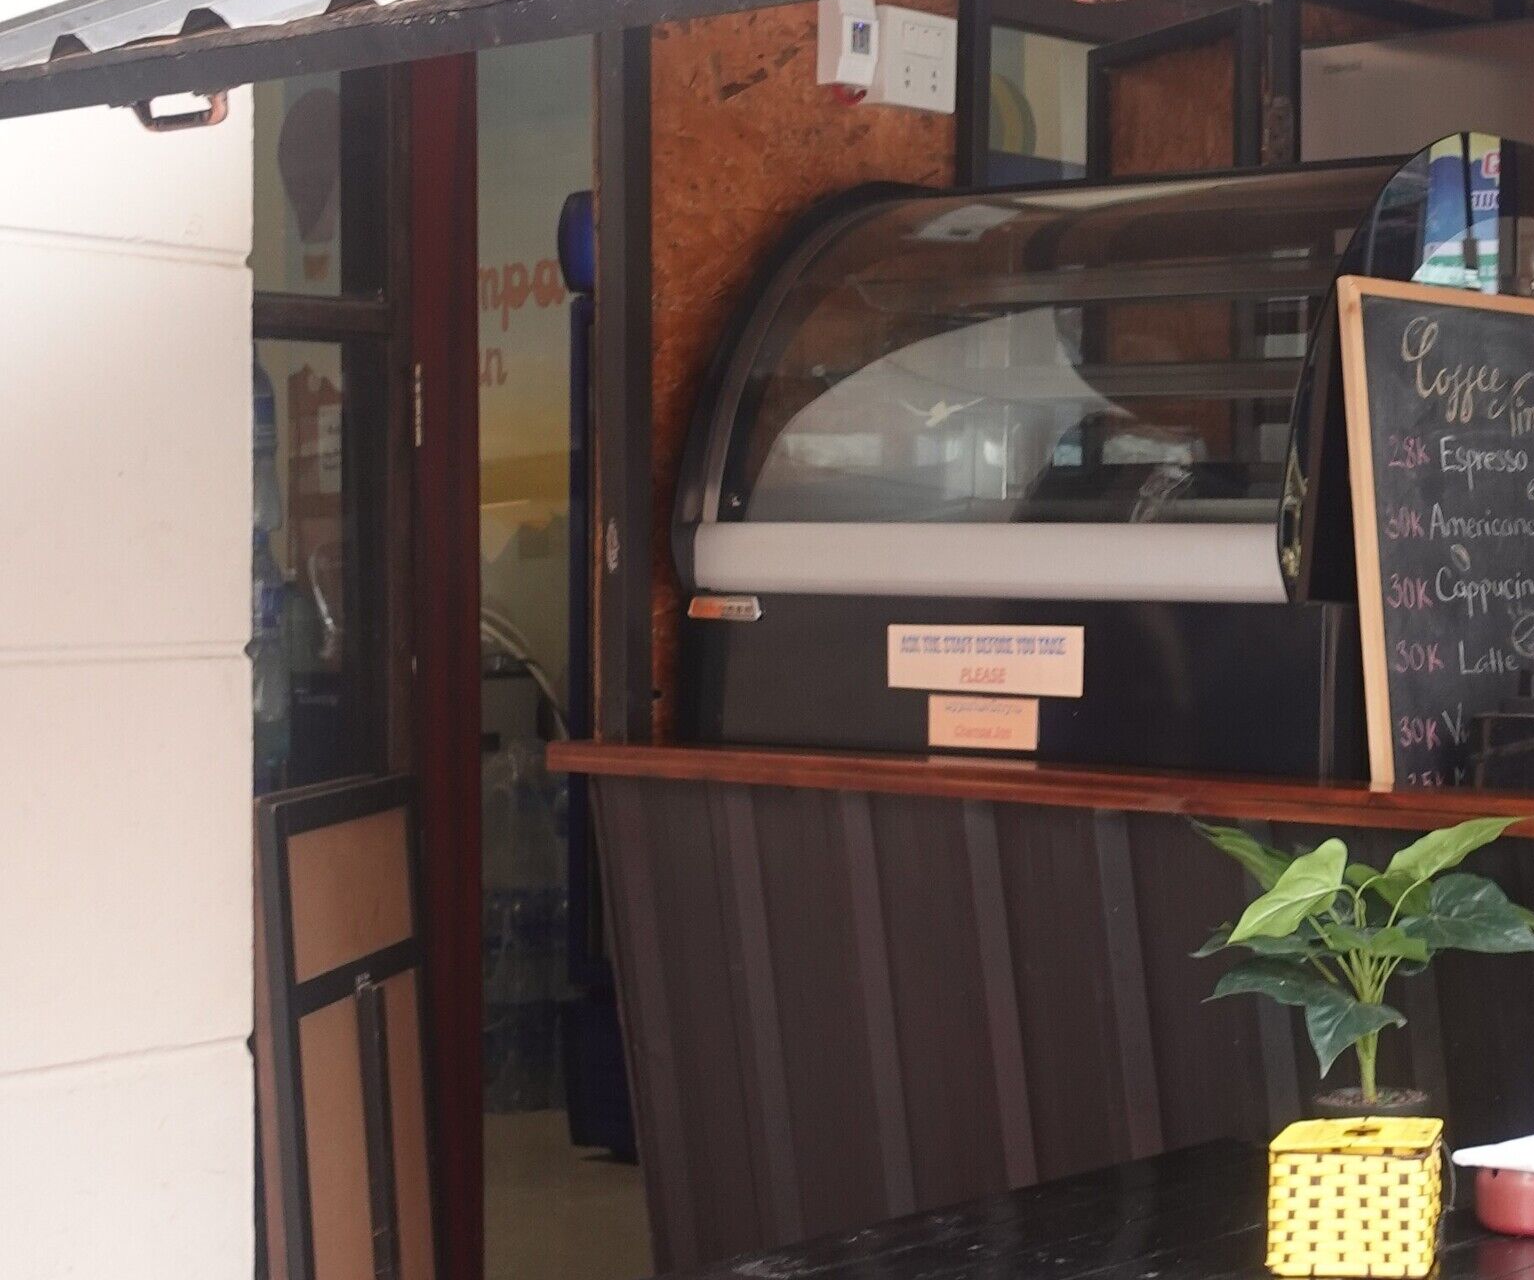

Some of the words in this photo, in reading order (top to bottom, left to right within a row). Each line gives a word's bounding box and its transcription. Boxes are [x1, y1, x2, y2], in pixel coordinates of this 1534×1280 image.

[1401, 316, 1509, 424] Coffee
[1439, 434, 1529, 490] Espresso
[959, 666, 1007, 685] PLEASE
